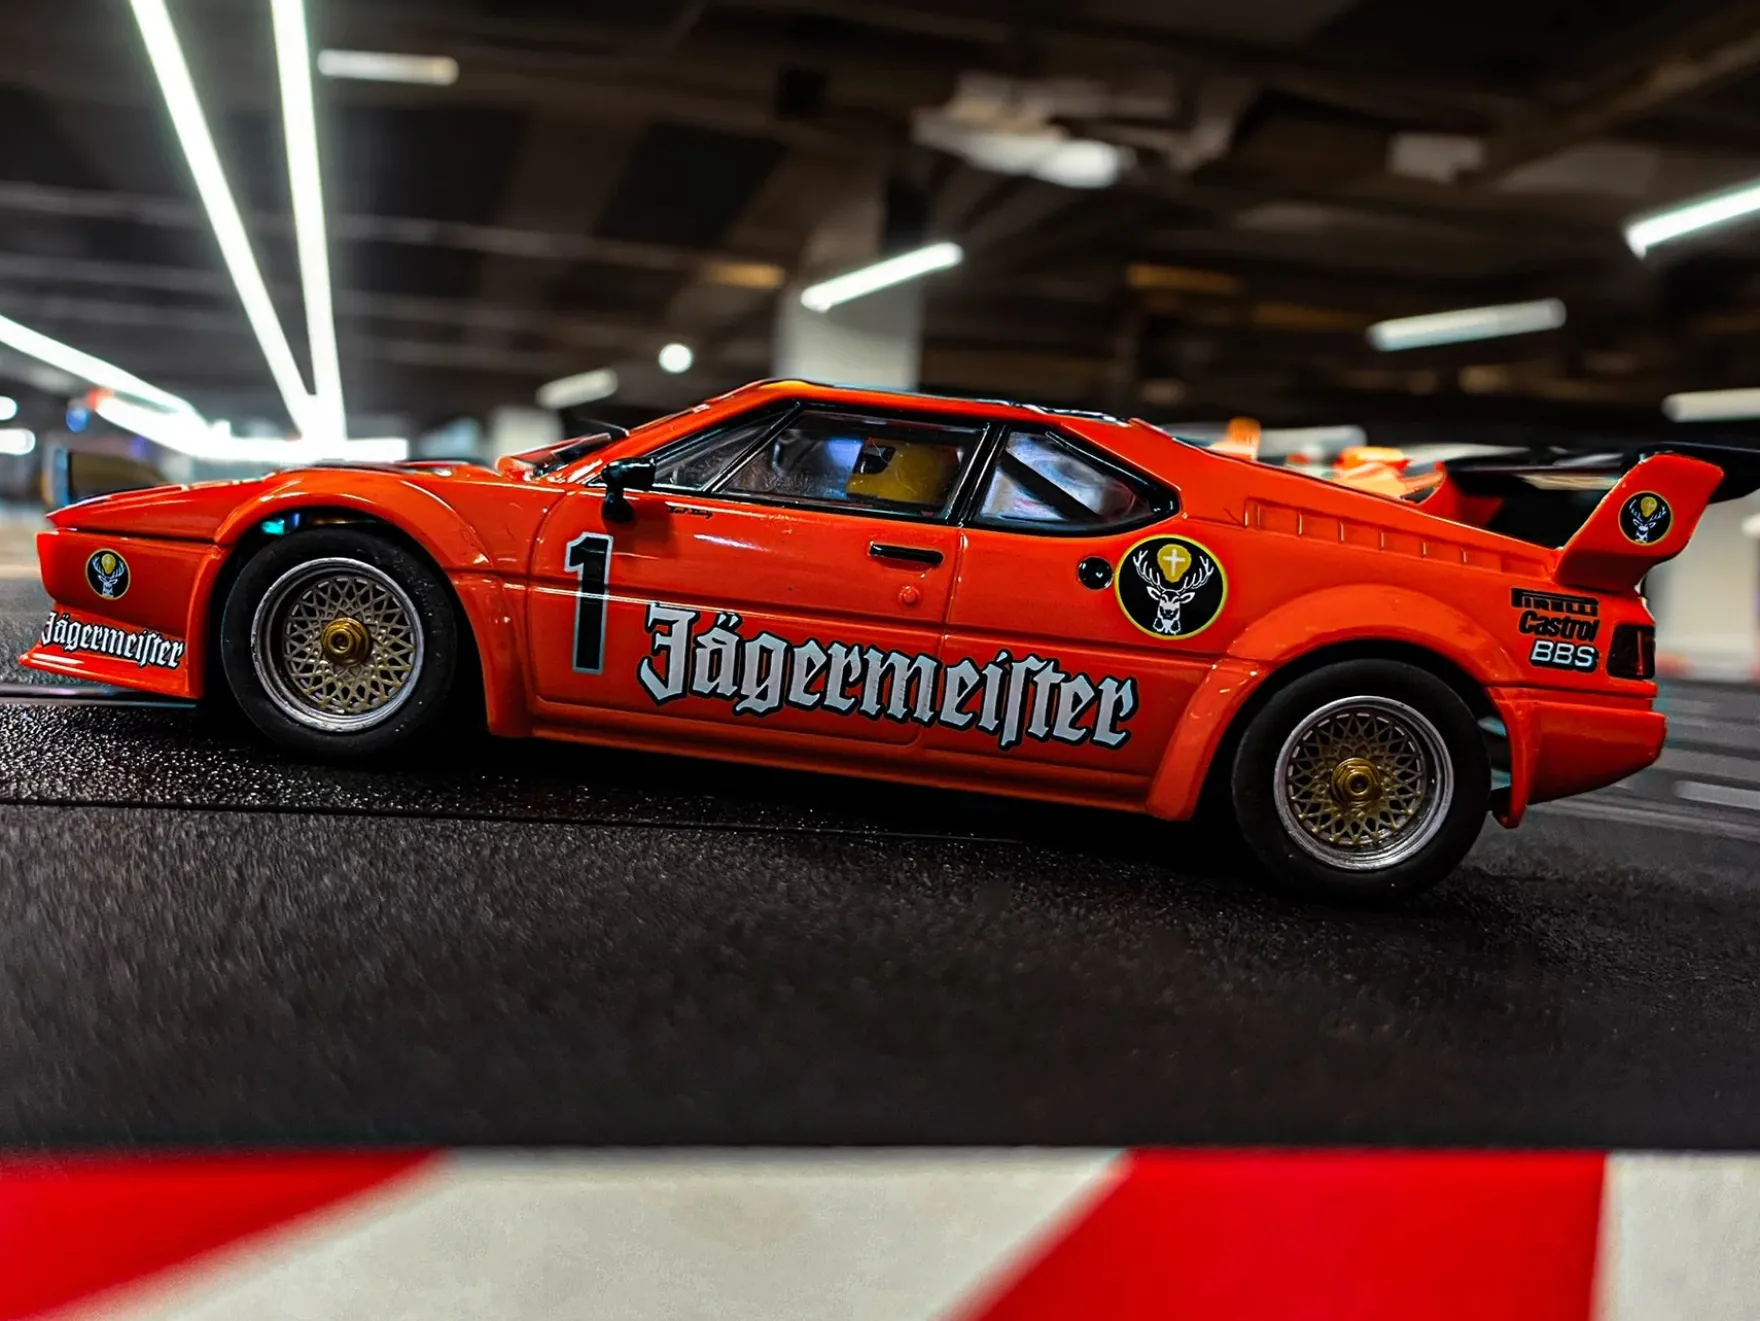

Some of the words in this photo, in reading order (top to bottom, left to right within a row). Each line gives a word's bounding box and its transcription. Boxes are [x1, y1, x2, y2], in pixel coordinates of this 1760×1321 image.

[564, 531, 614, 675] 1
[1511, 588, 1599, 616] PIRELLI
[1519, 610, 1599, 642] Castrol
[1530, 639, 1598, 671] BBS
